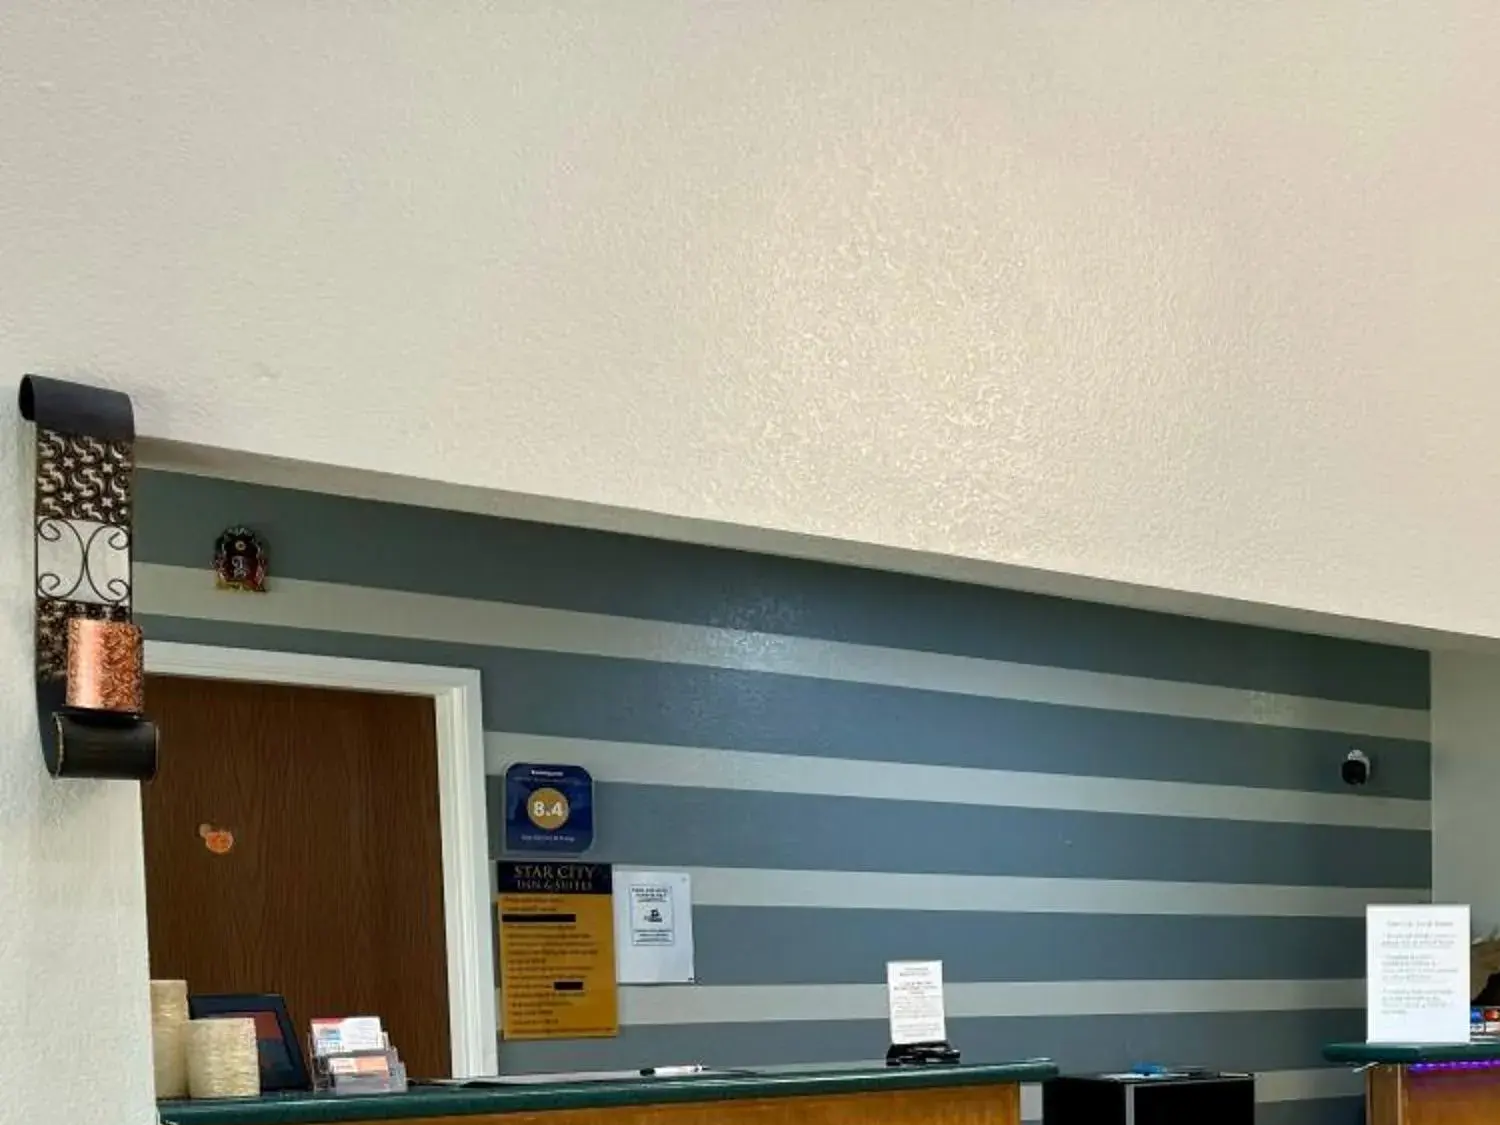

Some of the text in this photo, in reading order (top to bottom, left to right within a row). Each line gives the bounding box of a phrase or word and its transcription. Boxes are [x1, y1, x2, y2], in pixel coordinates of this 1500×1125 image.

[533, 800, 563, 817] 8.4
[514, 864, 595, 879] STAR CITY
[517, 879, 541, 889] INN
